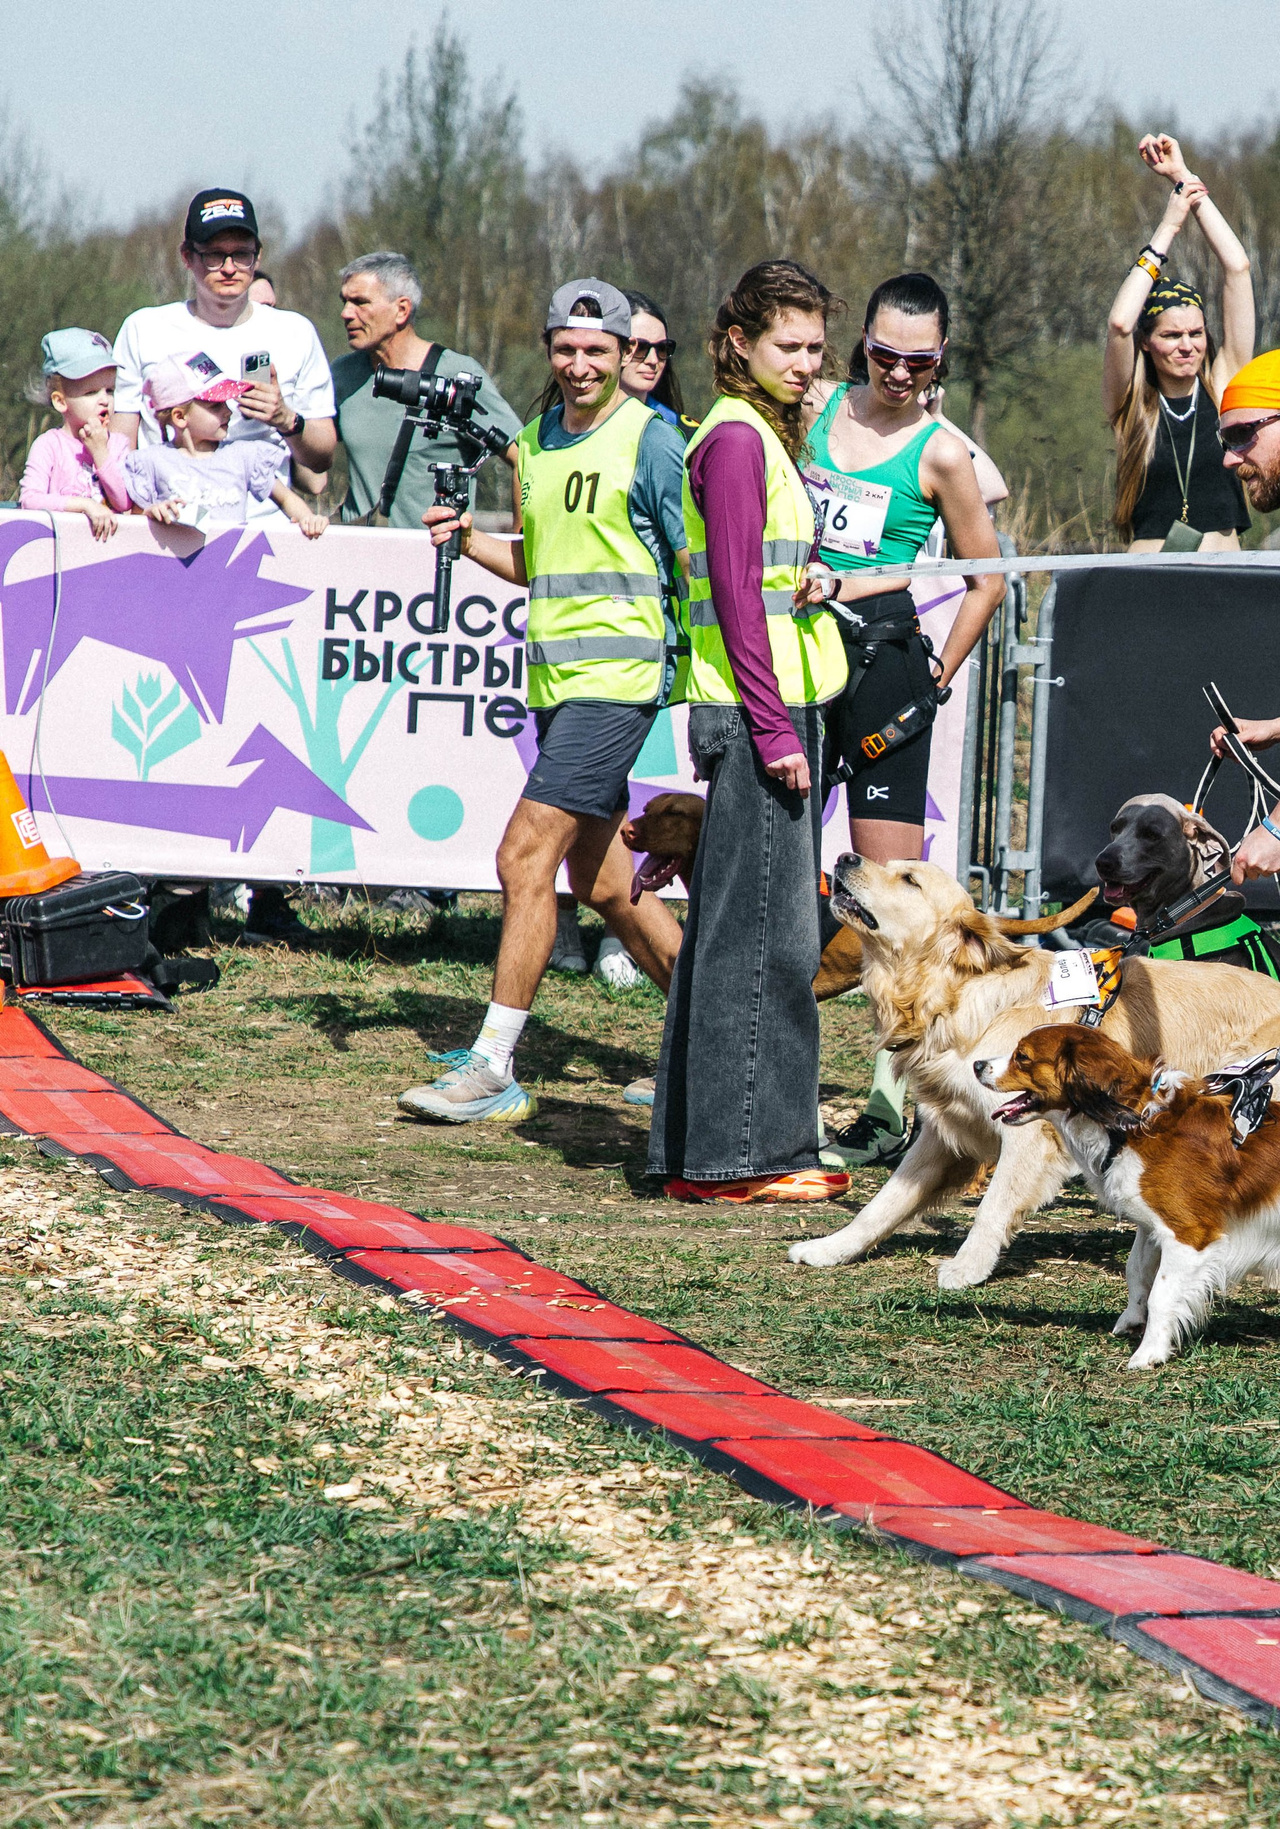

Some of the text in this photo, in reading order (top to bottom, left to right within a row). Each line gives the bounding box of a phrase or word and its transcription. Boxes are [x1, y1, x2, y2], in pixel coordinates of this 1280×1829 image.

[564, 470, 601, 514] 01
[820, 498, 848, 531] 16
[322, 637, 524, 689] БЫСТРЫ
